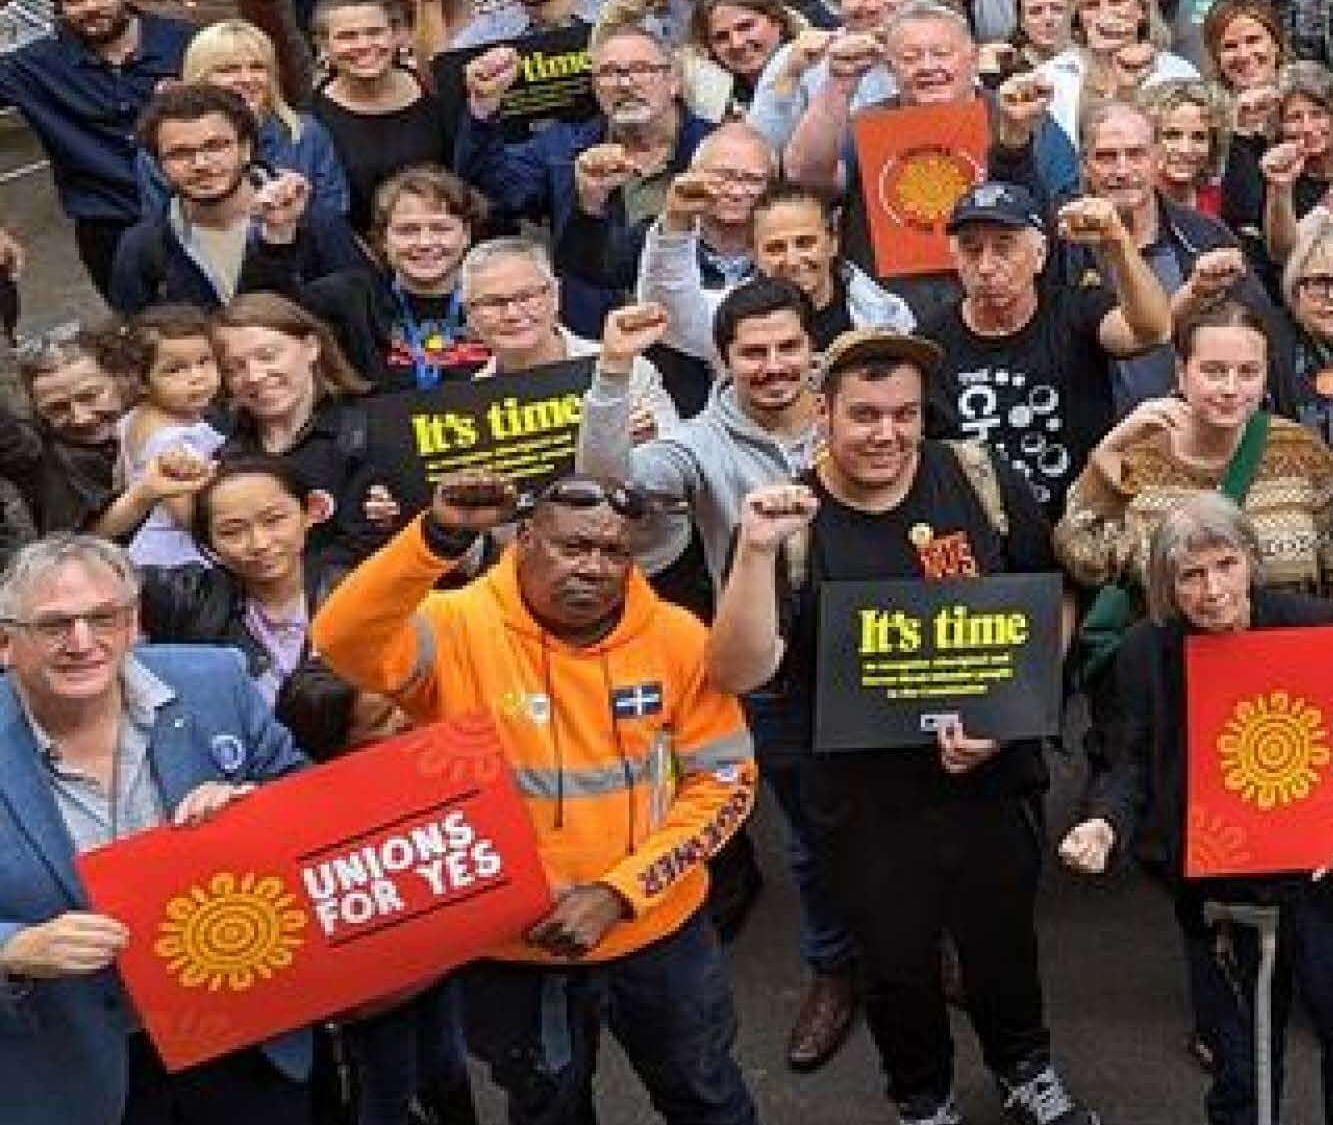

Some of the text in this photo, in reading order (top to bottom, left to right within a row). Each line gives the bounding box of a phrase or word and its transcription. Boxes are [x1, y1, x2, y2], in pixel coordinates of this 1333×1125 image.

[410, 393, 586, 455] It's time
[858, 605, 1030, 653] It's time
[303, 809, 474, 899] UNIONS
[316, 838, 502, 938] FOR YES
